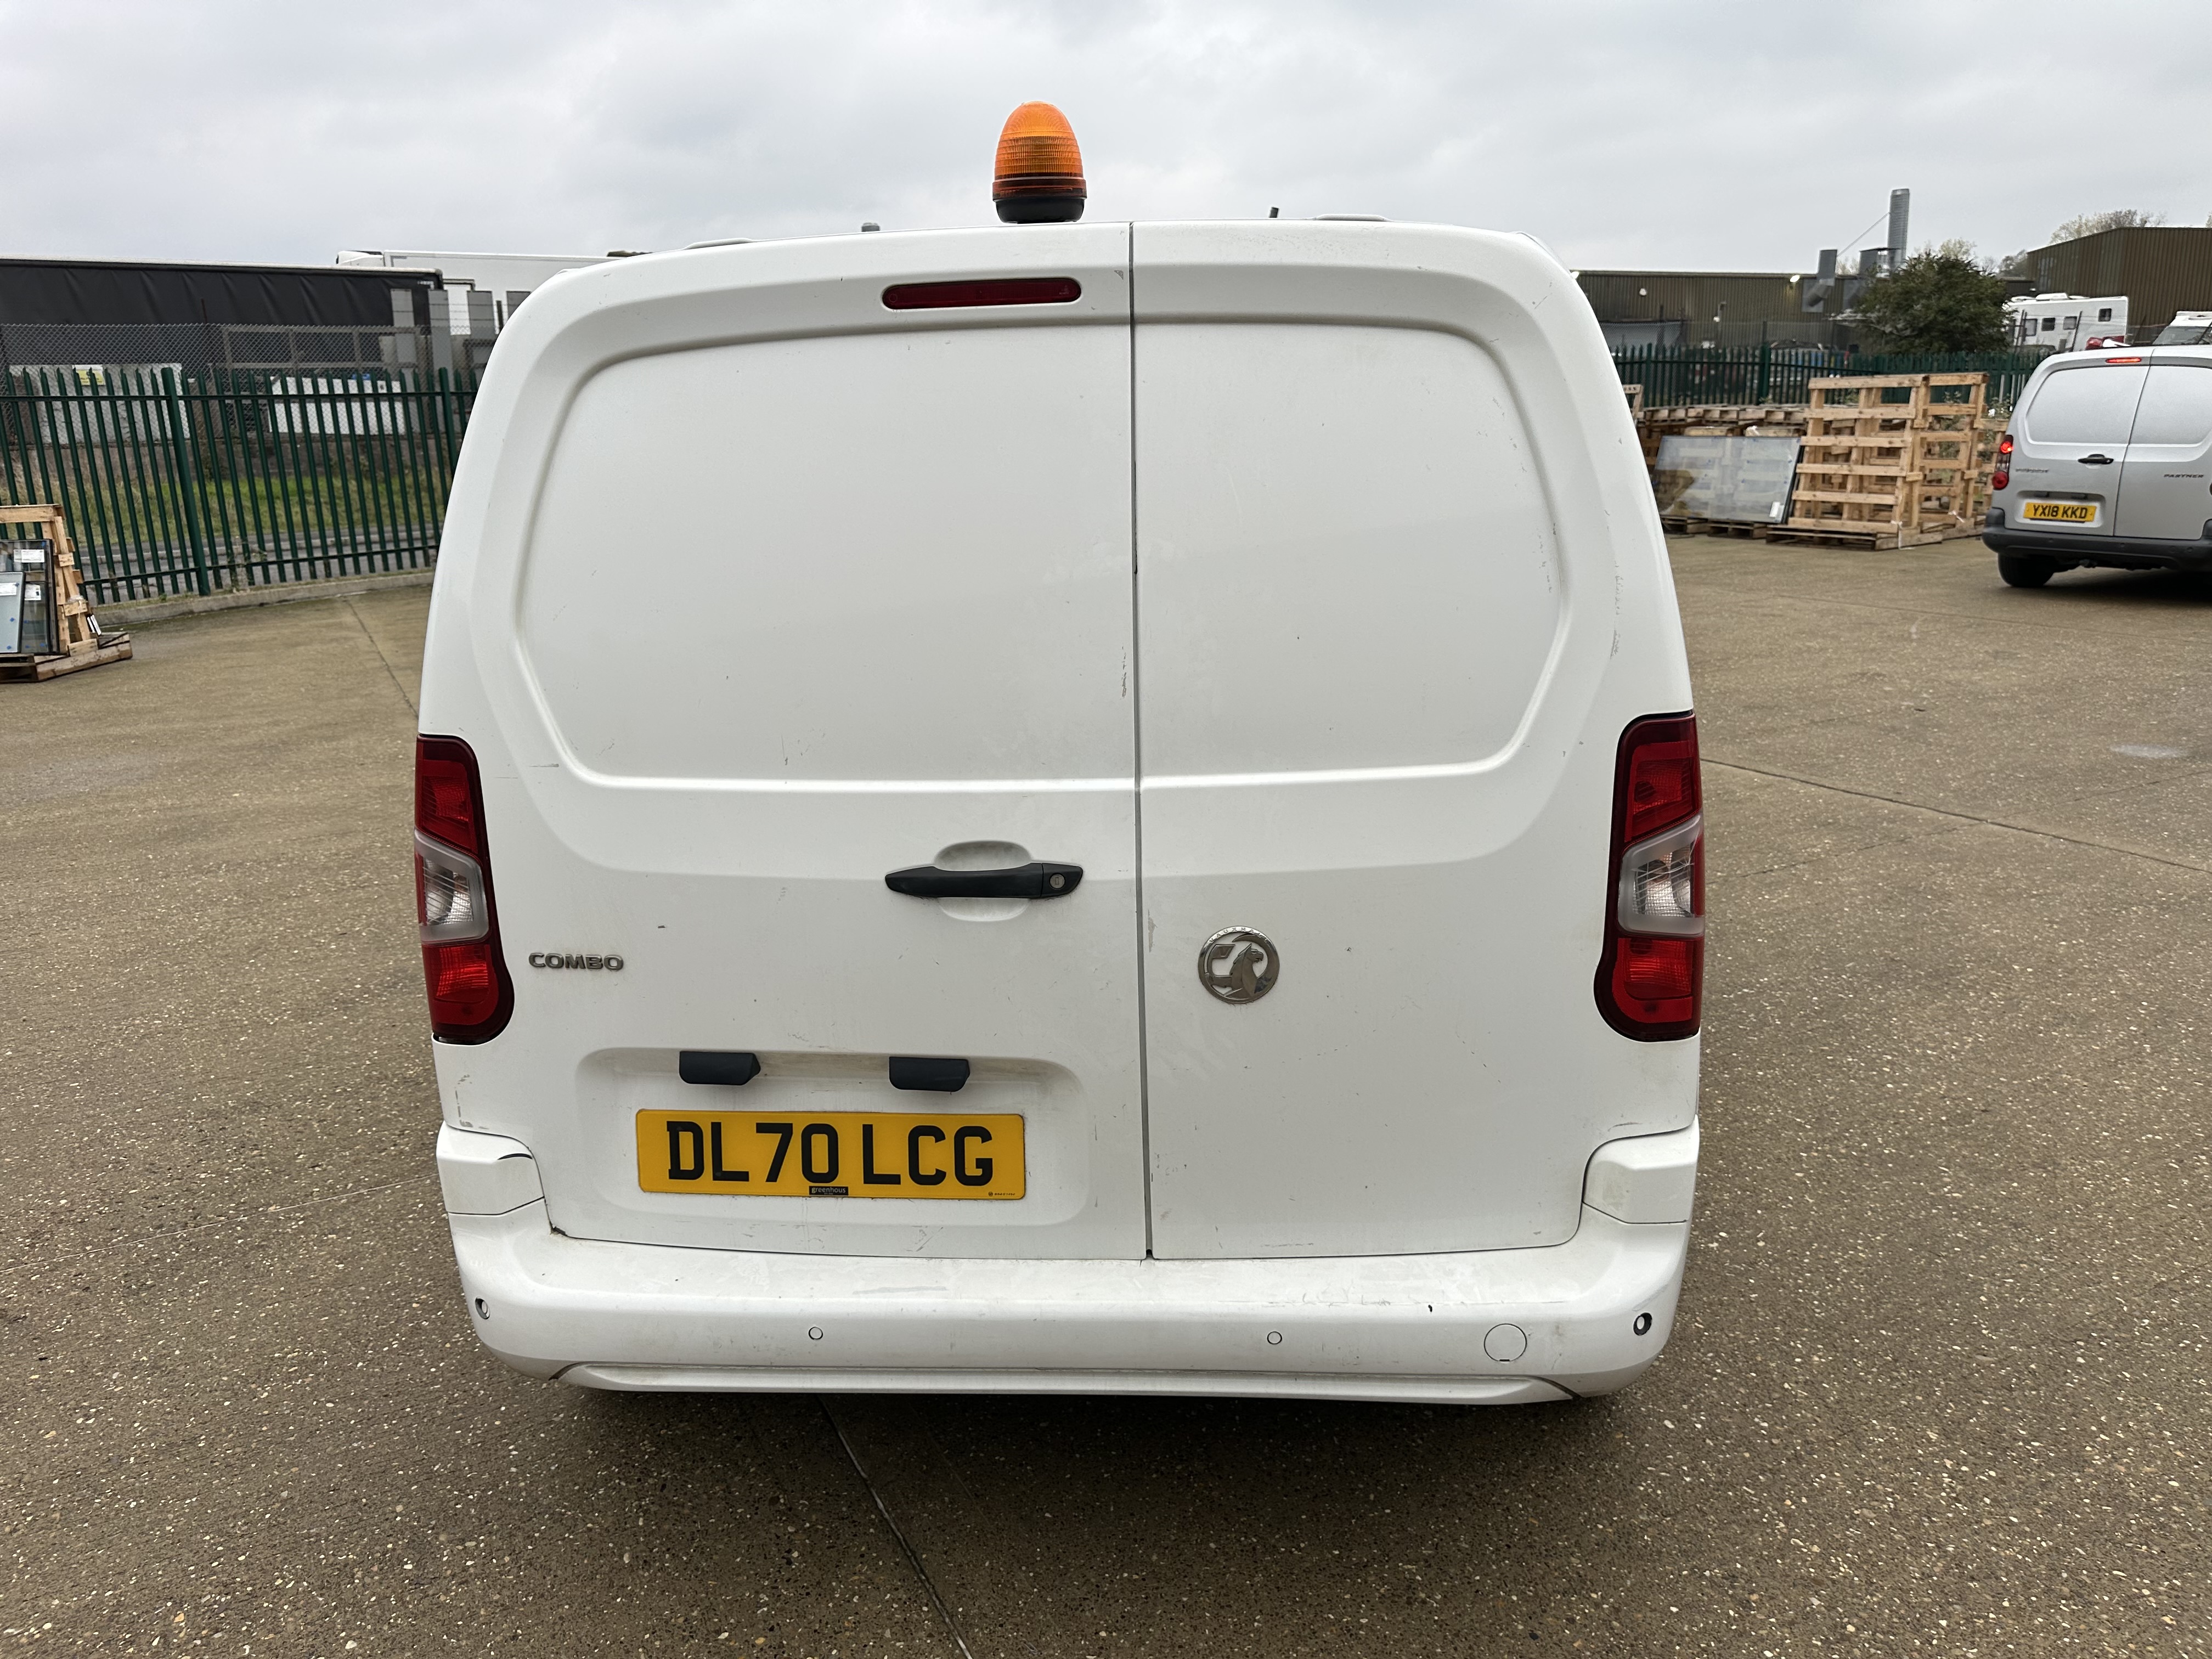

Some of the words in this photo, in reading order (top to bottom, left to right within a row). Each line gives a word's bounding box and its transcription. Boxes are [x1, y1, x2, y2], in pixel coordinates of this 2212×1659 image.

[2033, 505, 2059, 517] YX18
[2062, 506, 2088, 518] KKD
[528, 952, 624, 970] COMBO
[667, 1120, 839, 1184] DL70
[863, 1124, 993, 1186] LCG
